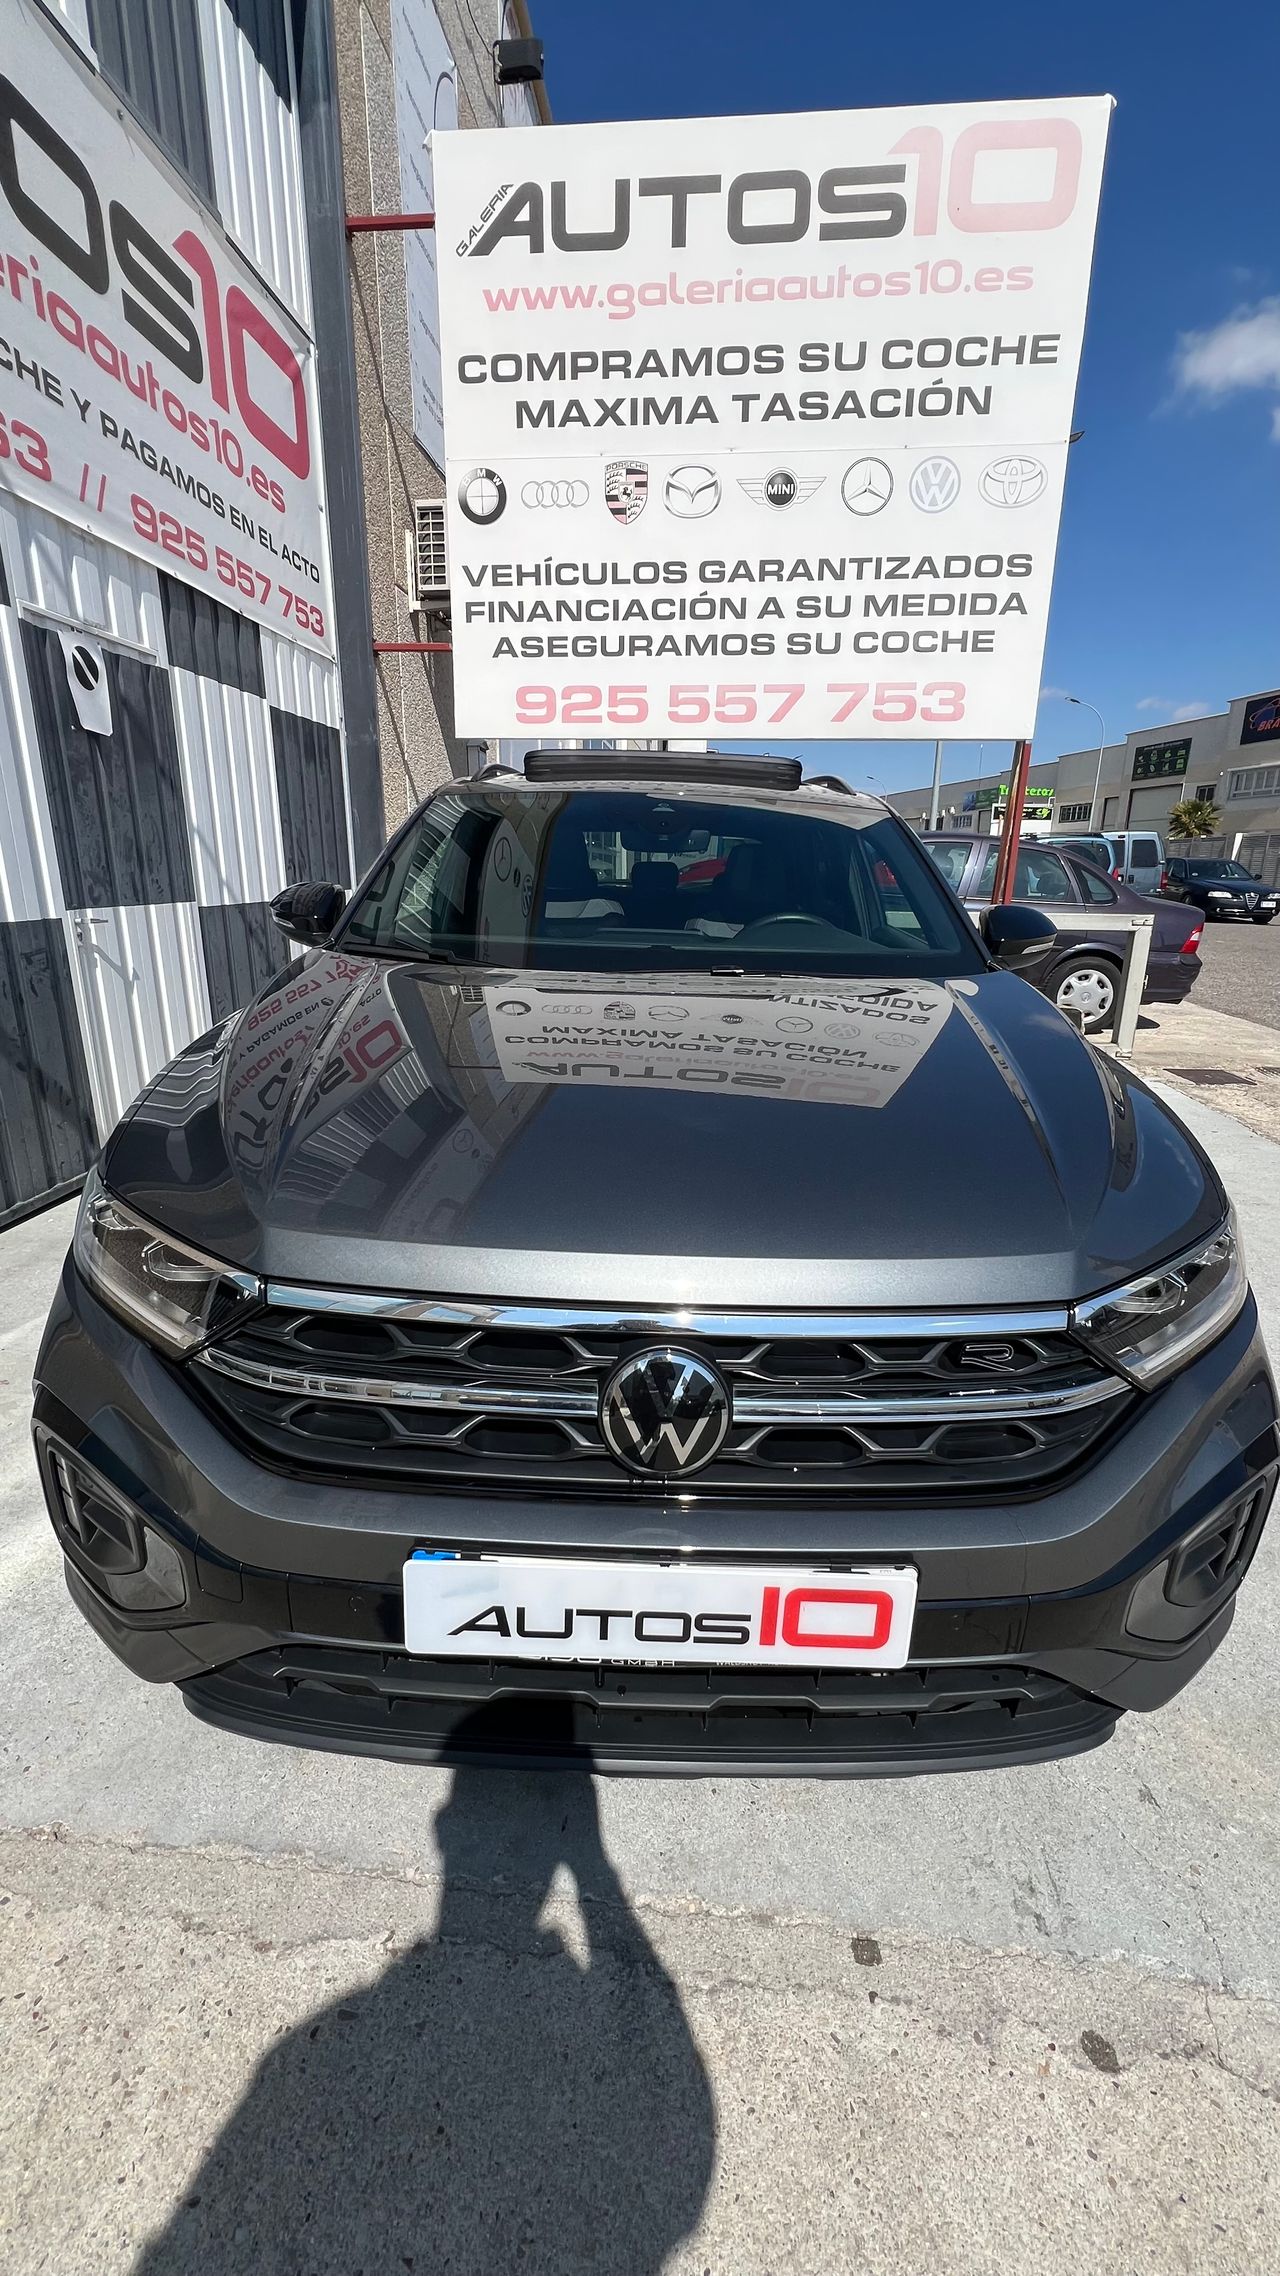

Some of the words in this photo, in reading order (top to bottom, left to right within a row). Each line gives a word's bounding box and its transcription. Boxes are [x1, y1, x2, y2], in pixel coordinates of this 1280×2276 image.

[456, 184, 513, 257] GALERIA
[484, 259, 1033, 319] www.galeriaautos10.es
[0, 252, 286, 514] riaautos10.es
[458, 345, 784, 384] COMPRAMOS
[799, 341, 867, 372] SU
[882, 334, 1061, 369] COCHE
[516, 396, 719, 428] MAXIMA
[732, 378, 992, 422] TASACIÓN
[70, 388, 91, 423] Y
[99, 409, 225, 519] PAGAMOS
[229, 504, 255, 540] EN
[258, 525, 278, 555] EL
[281, 544, 320, 584] ACTO
[768, 483, 793, 496] MINI
[130, 493, 208, 572] 925
[215, 545, 272, 605] 557
[278, 584, 325, 637] 753
[462, 556, 687, 588] VEHÍCULOS
[699, 553, 1033, 583] GARANTIZADOS
[466, 591, 747, 623] FINANCIACIÓN
[756, 597, 785, 620] A
[795, 595, 852, 618] SU
[864, 591, 1028, 618] MEDIDA
[492, 633, 776, 658] ASEGURAMOS
[786, 631, 842, 655] SU
[853, 630, 995, 655] COCHE
[515, 686, 649, 724] 925
[668, 684, 805, 724] 557
[826, 682, 966, 723] 753
